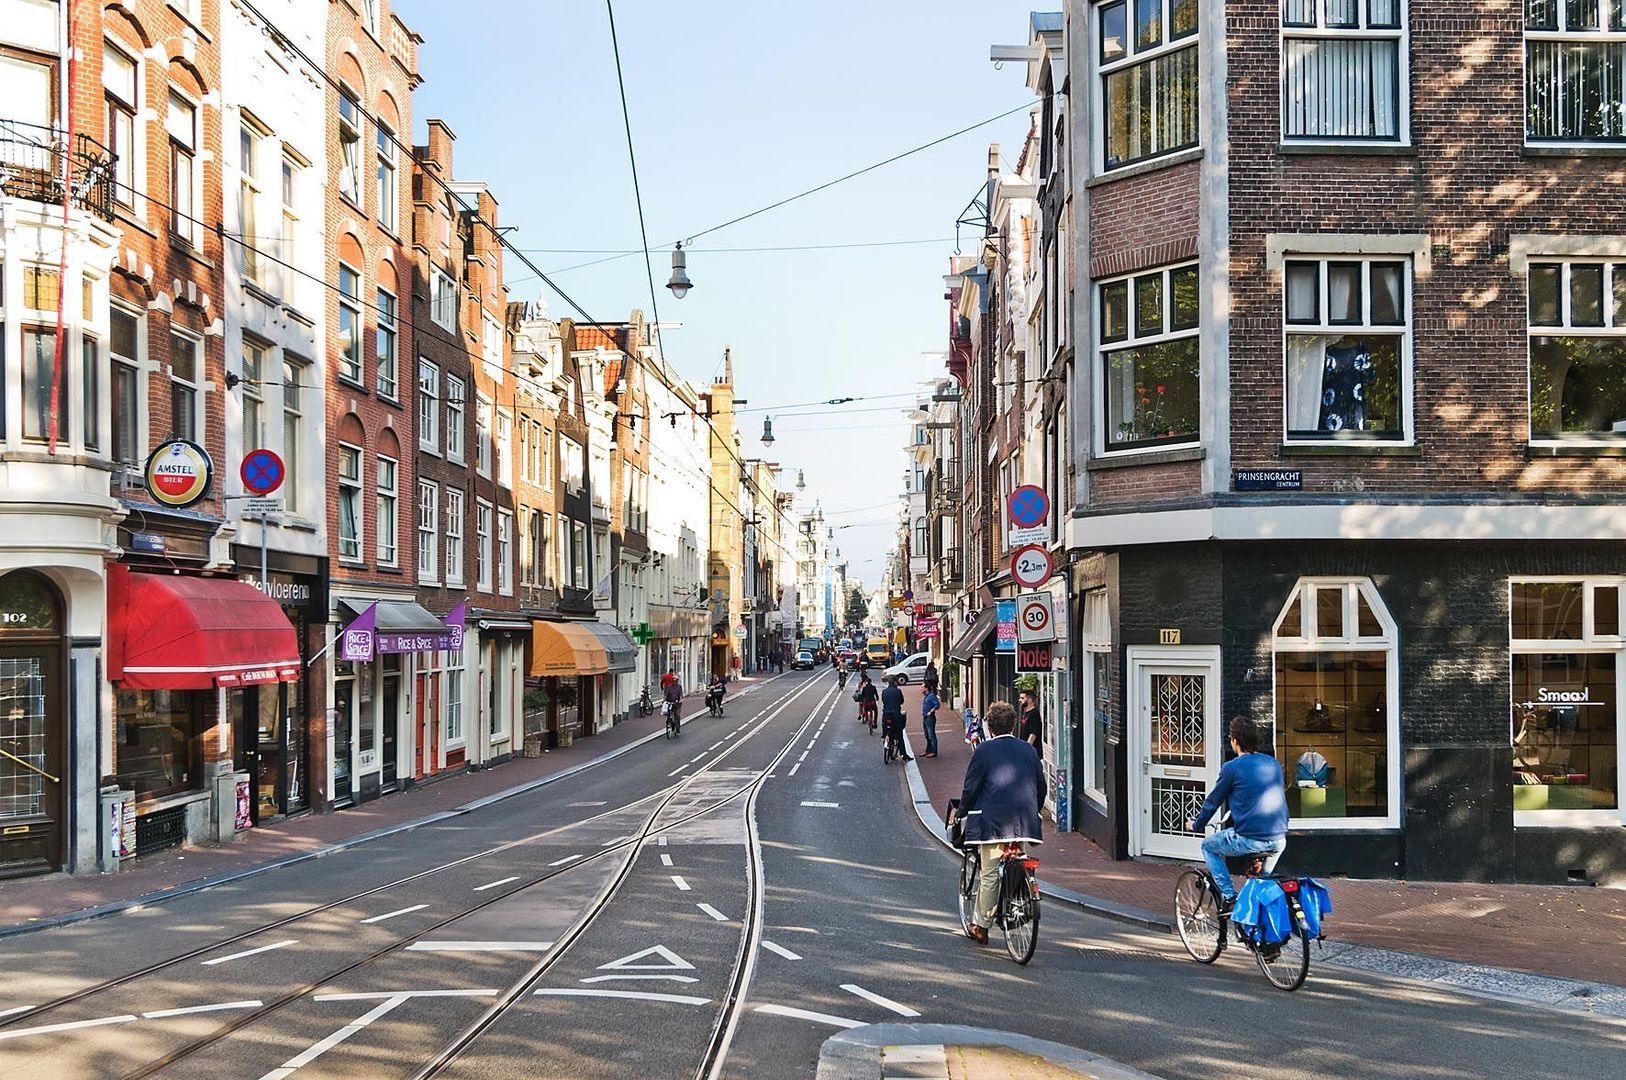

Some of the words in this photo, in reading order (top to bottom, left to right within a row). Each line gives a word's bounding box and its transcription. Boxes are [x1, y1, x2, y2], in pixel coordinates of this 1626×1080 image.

[157, 464, 194, 475] AMSTEL
[163, 476, 184, 484] BIER
[1238, 471, 1300, 481] PRINSENGRACHT
[2, 612, 28, 623] 102
[1028, 611, 1044, 623] 30
[1162, 630, 1178, 643] 117
[1018, 644, 1051, 668] hotel
